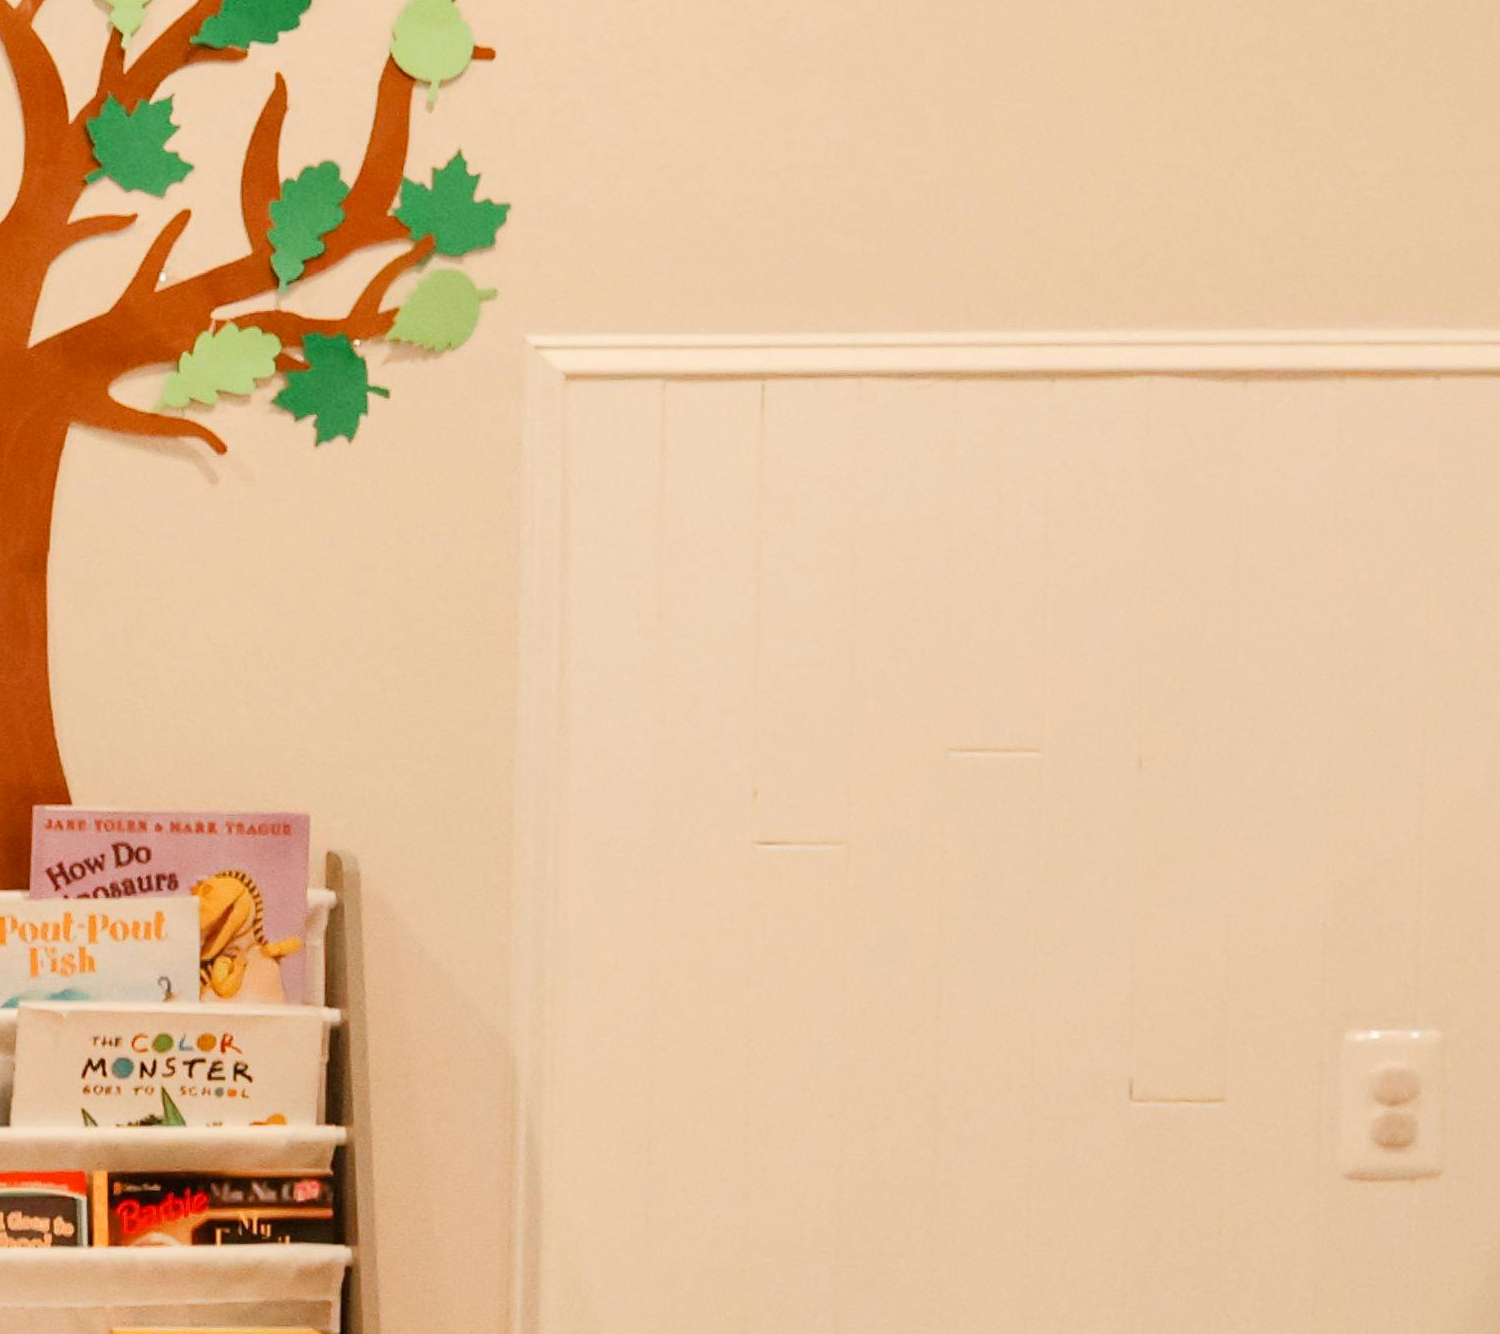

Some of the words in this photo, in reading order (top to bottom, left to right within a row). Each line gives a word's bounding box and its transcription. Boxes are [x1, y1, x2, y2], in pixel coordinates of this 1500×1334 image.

[45, 853, 106, 892] How
[111, 841, 152, 869] Do
[28, 945, 97, 979] Fish
[91, 1035, 123, 1049] THE
[130, 1032, 243, 1055] COLOR
[80, 1056, 254, 1084] MONSTER
[113, 1186, 210, 1235] Barbie
